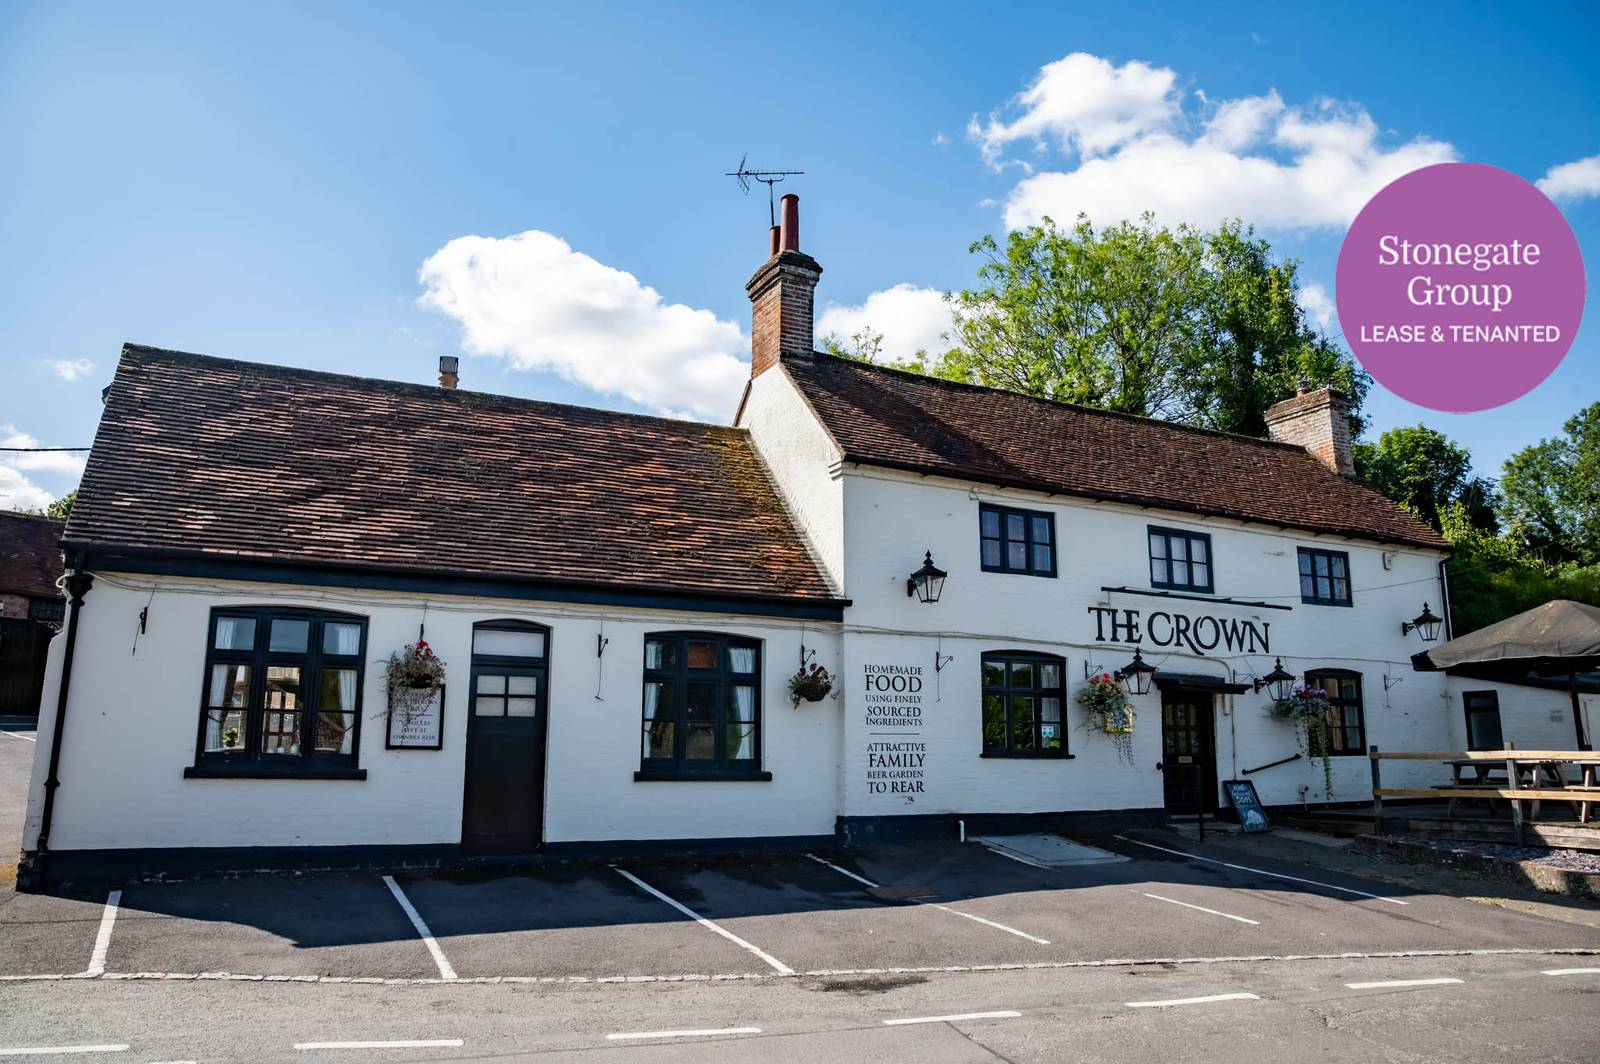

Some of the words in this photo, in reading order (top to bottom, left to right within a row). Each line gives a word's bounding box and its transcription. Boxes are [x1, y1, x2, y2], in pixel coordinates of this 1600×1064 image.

[1088, 607, 1142, 643] THE
[1148, 612, 1270, 655] CROWN
[864, 665, 922, 675] HOMEMADE
[866, 675, 922, 692] FOOD
[867, 706, 921, 716] SOURCED
[866, 717, 922, 726] INGREDIENTS
[867, 743, 926, 752] ATTRACTIVE
[869, 754, 926, 767] FAMILY
[868, 771, 887, 779] BEER
[889, 770, 923, 778] GARDEN
[867, 782, 886, 793] TO
[892, 781, 924, 792] REAR
